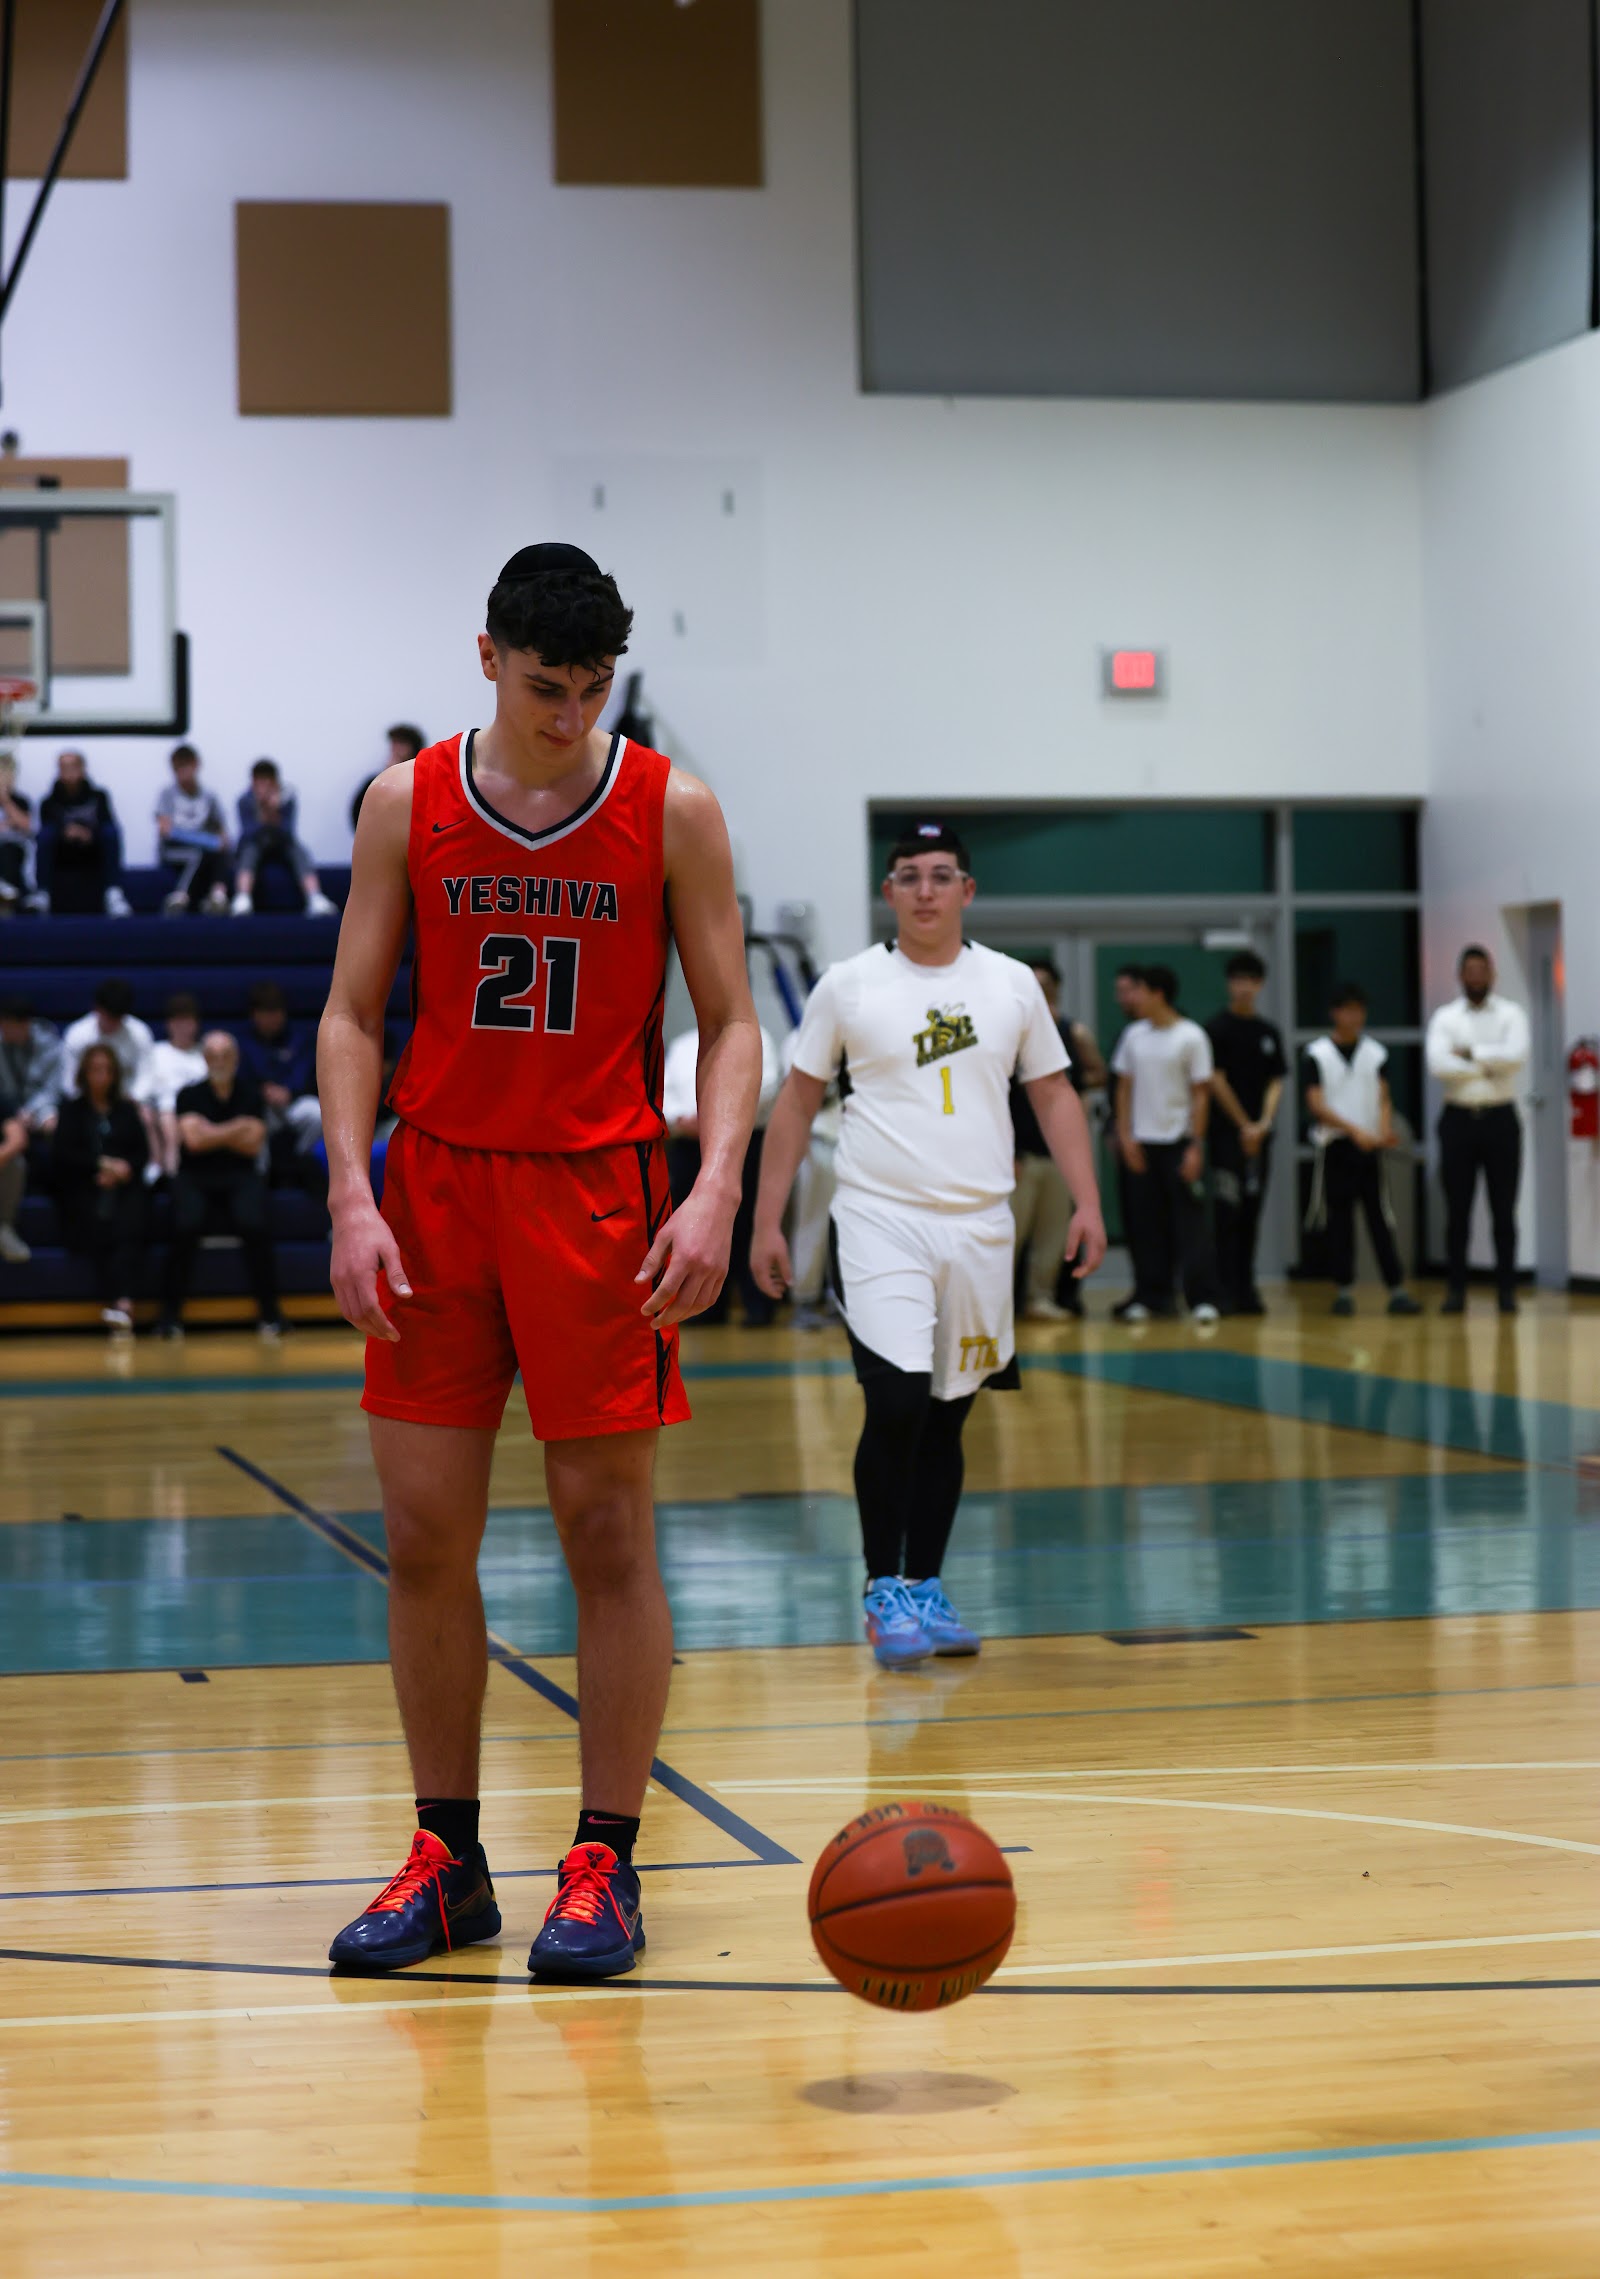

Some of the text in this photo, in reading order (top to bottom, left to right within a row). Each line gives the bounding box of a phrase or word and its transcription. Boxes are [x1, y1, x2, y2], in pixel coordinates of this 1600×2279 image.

[442, 875, 619, 922] YESHIVA
[471, 933, 581, 1035] 21
[940, 1066, 954, 1115] 1
